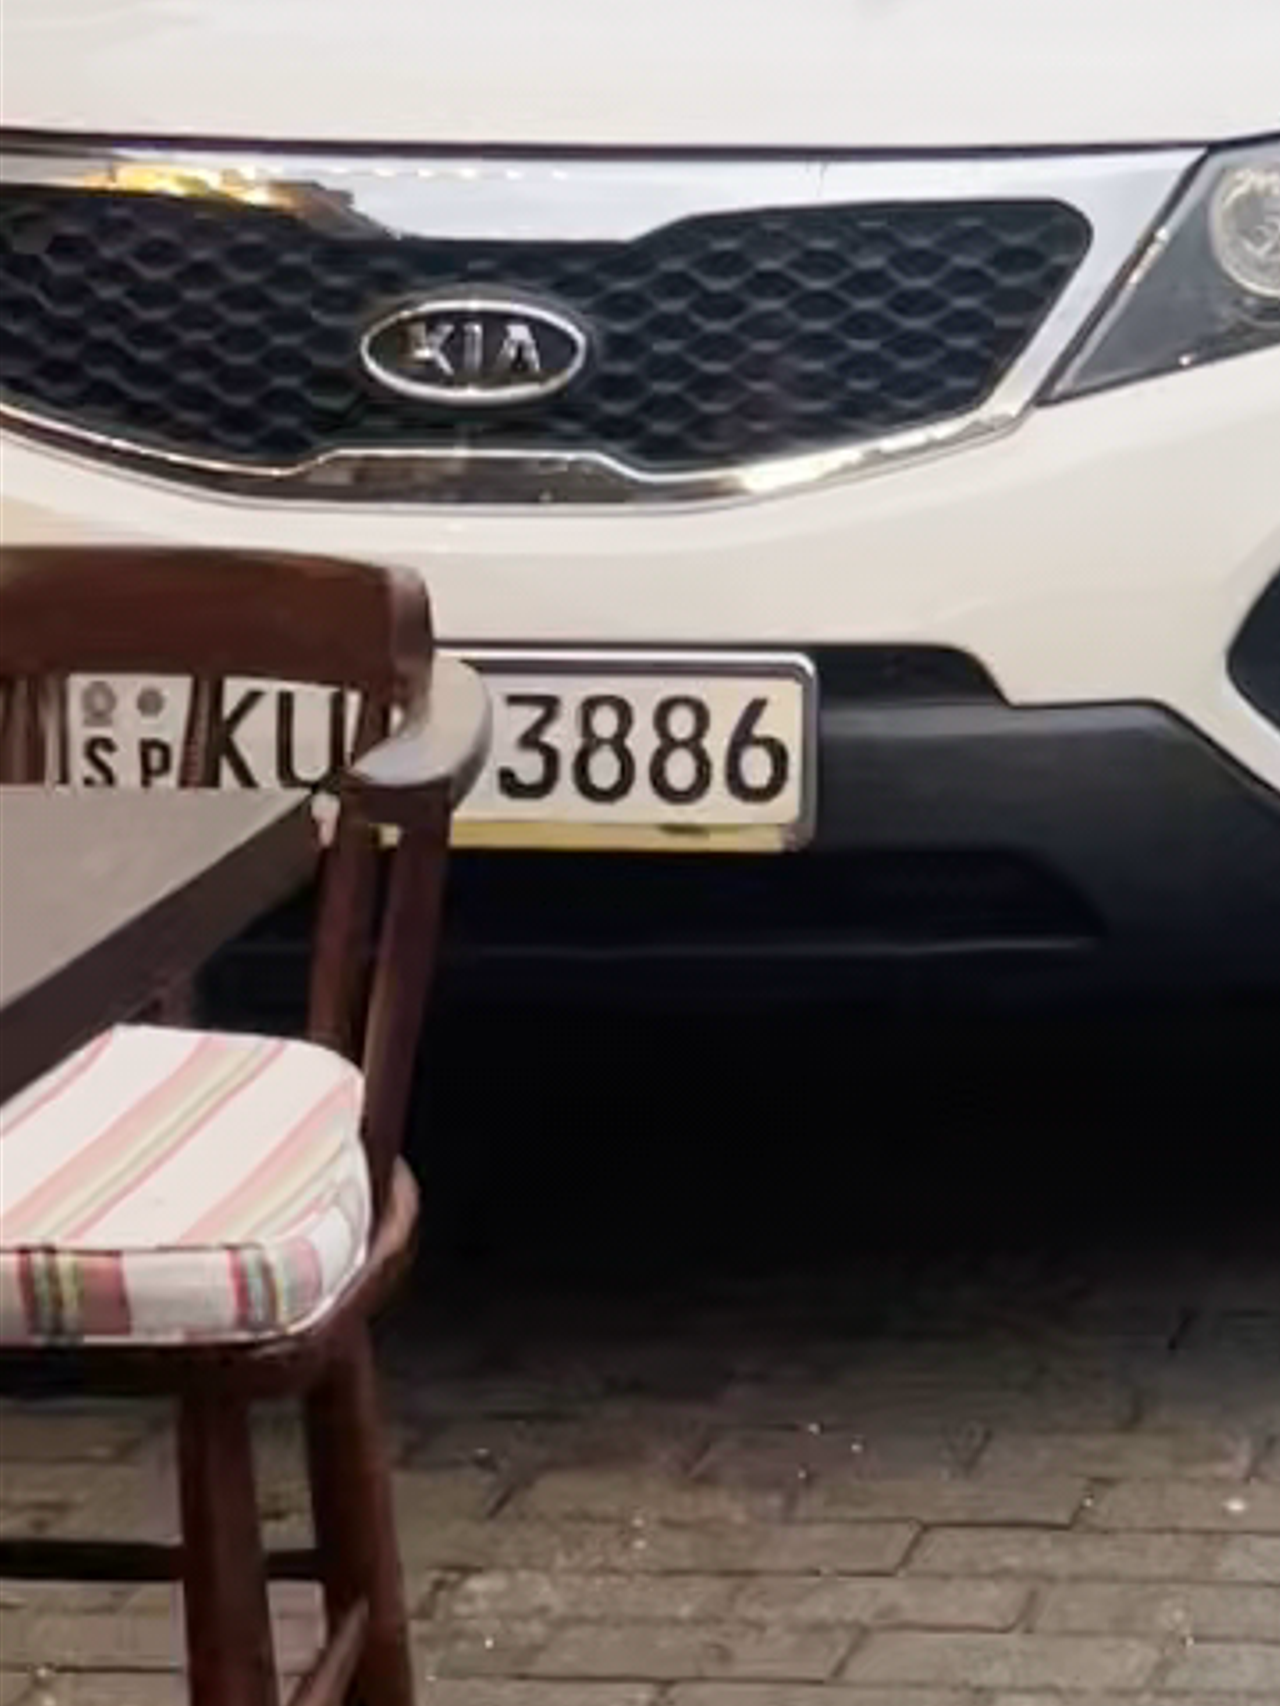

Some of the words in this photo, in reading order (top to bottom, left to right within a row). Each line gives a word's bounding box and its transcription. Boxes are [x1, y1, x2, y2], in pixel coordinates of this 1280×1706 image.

[405, 324, 541, 377] KIA
[211, 689, 345, 788] KU
[498, 693, 789, 805] 3886
